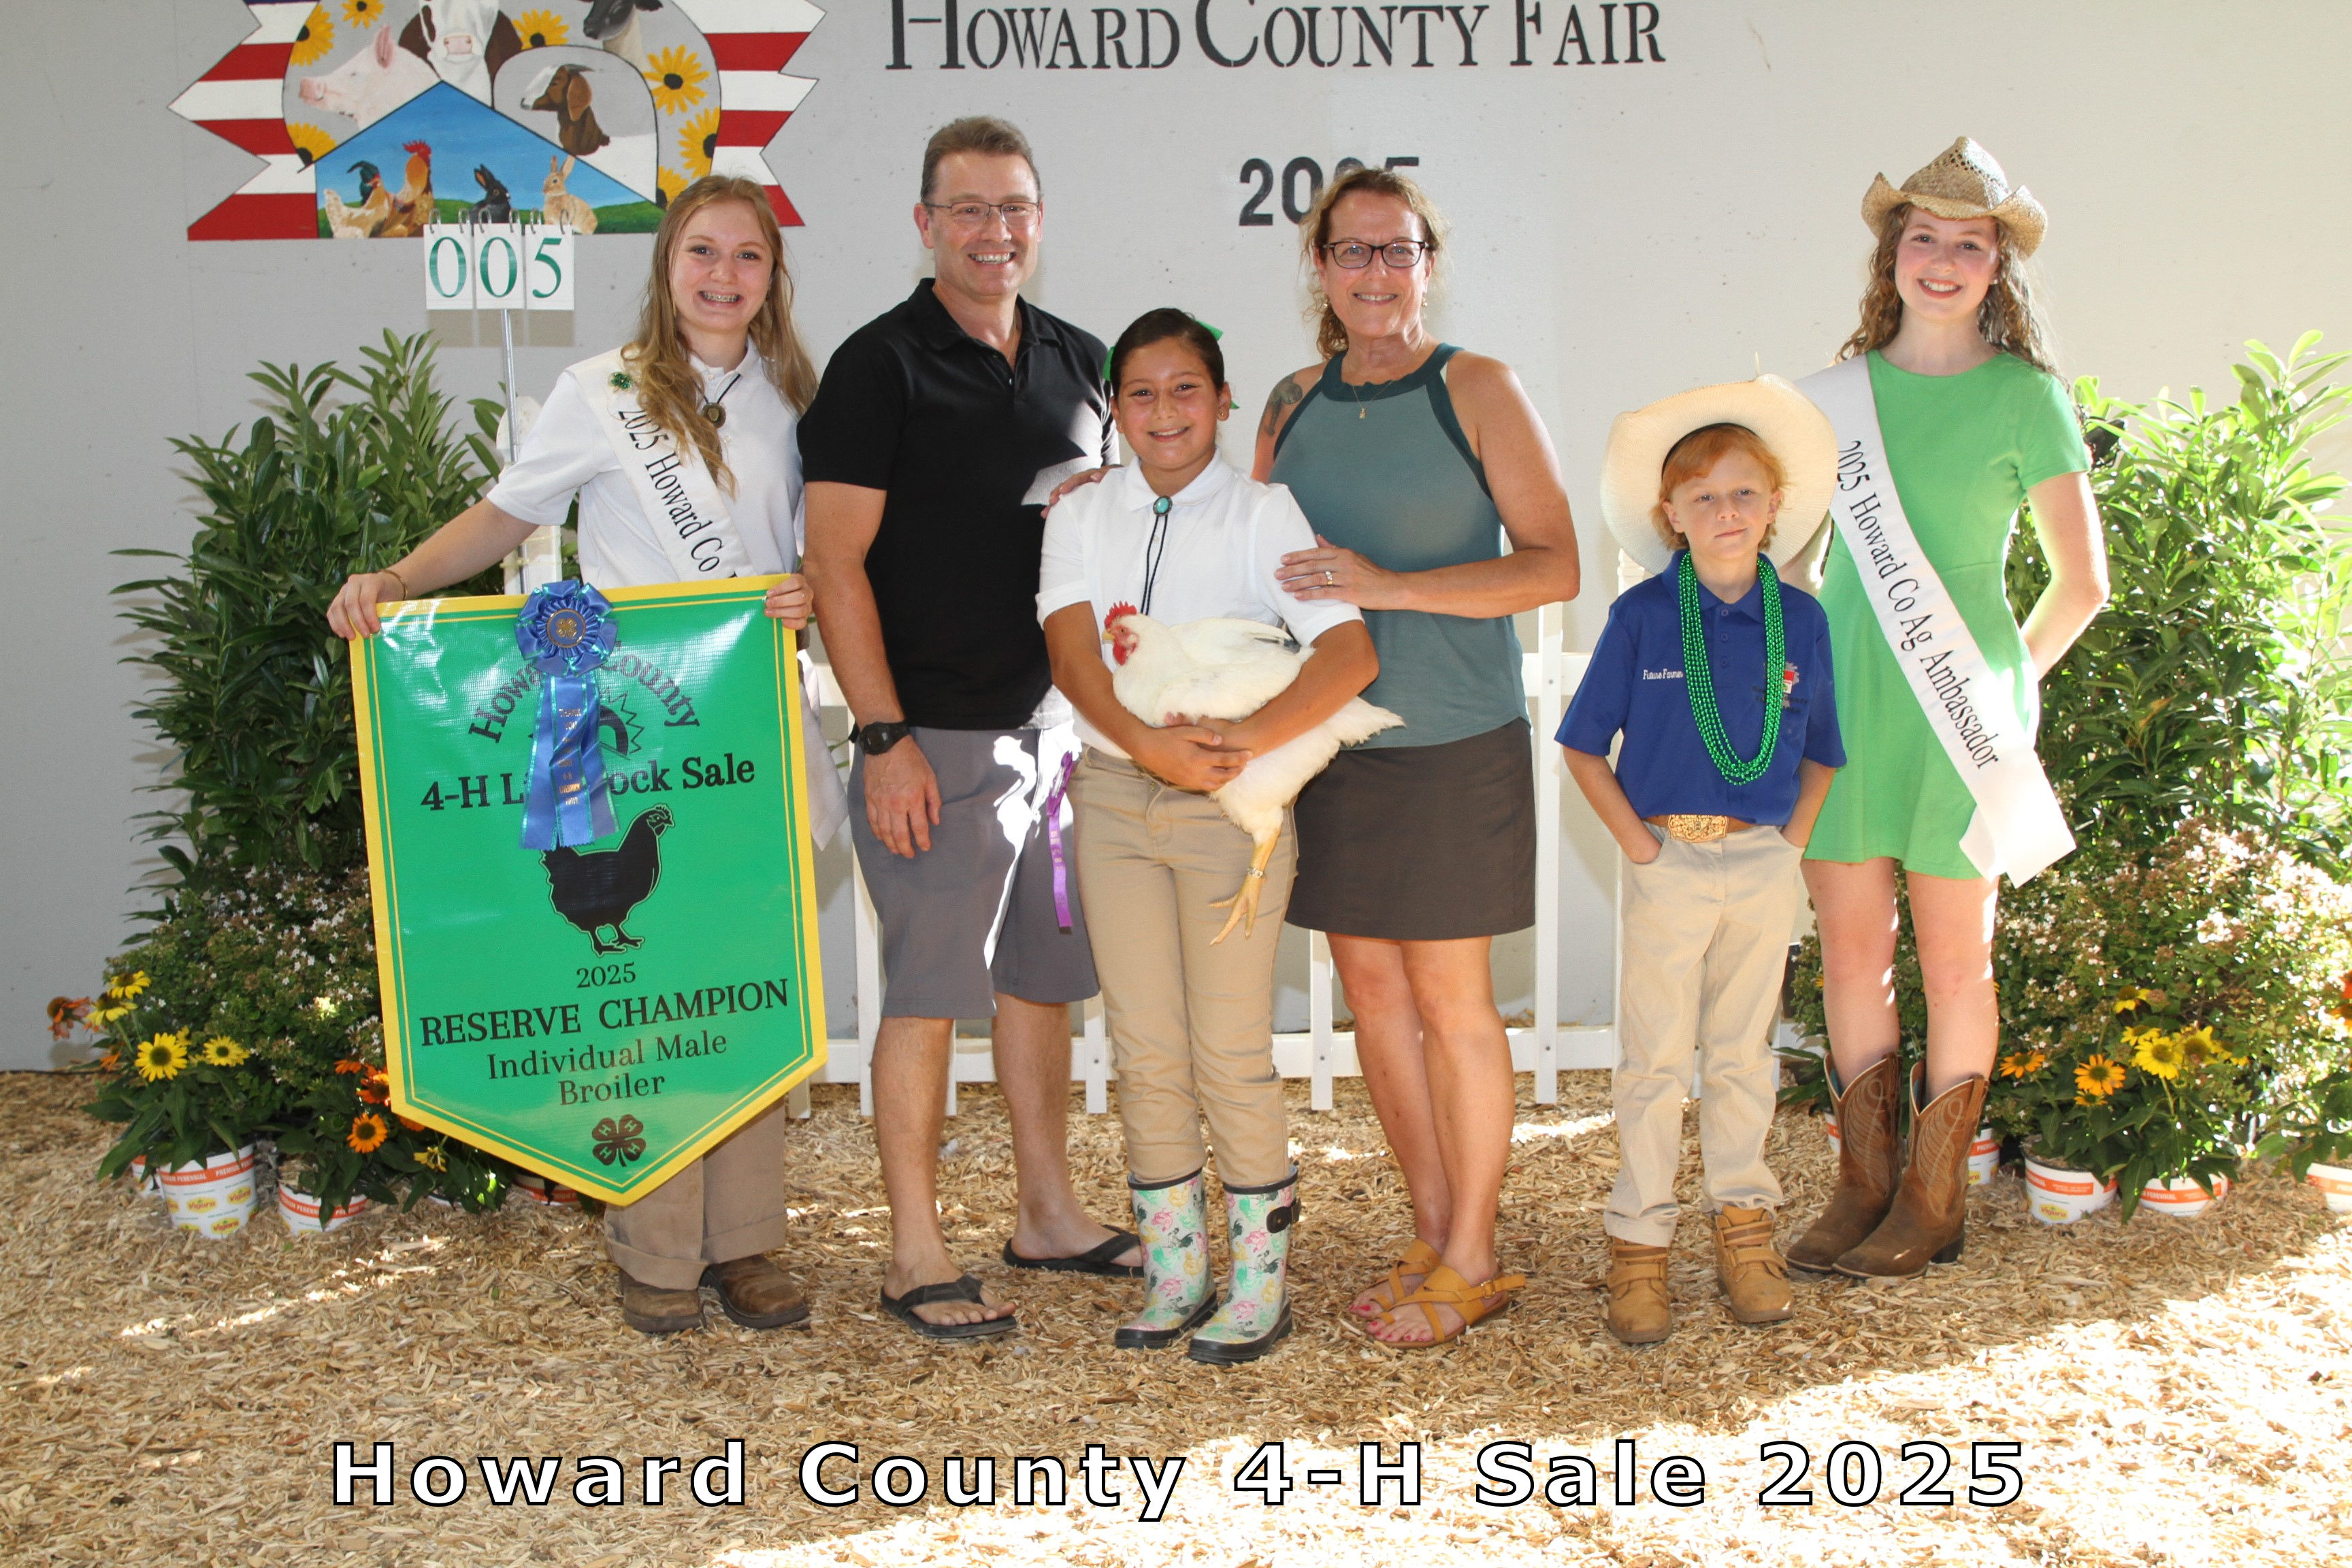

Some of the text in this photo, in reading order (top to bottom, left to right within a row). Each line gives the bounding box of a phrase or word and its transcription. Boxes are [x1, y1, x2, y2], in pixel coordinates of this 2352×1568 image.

[885, 0, 1666, 69] HOWARD COUNTY FAIR
[1239, 157, 1420, 227] 20
[429, 236, 562, 298] 005
[644, 451, 713, 540] Howard
[691, 537, 724, 572] Co
[1849, 492, 1908, 580] Howard
[1887, 578, 1919, 612] Co
[1899, 614, 1933, 652] Ag
[468, 662, 542, 743] Howa
[1920, 650, 1999, 770] Ambassador
[420, 774, 491, 811] 4-H
[682, 753, 755, 789] Sale
[576, 962, 636, 988] 2025
[419, 978, 788, 1047] RESERVE CHAMPION
[487, 1030, 728, 1079] Individual Male
[558, 1073, 666, 1106] Broiler
